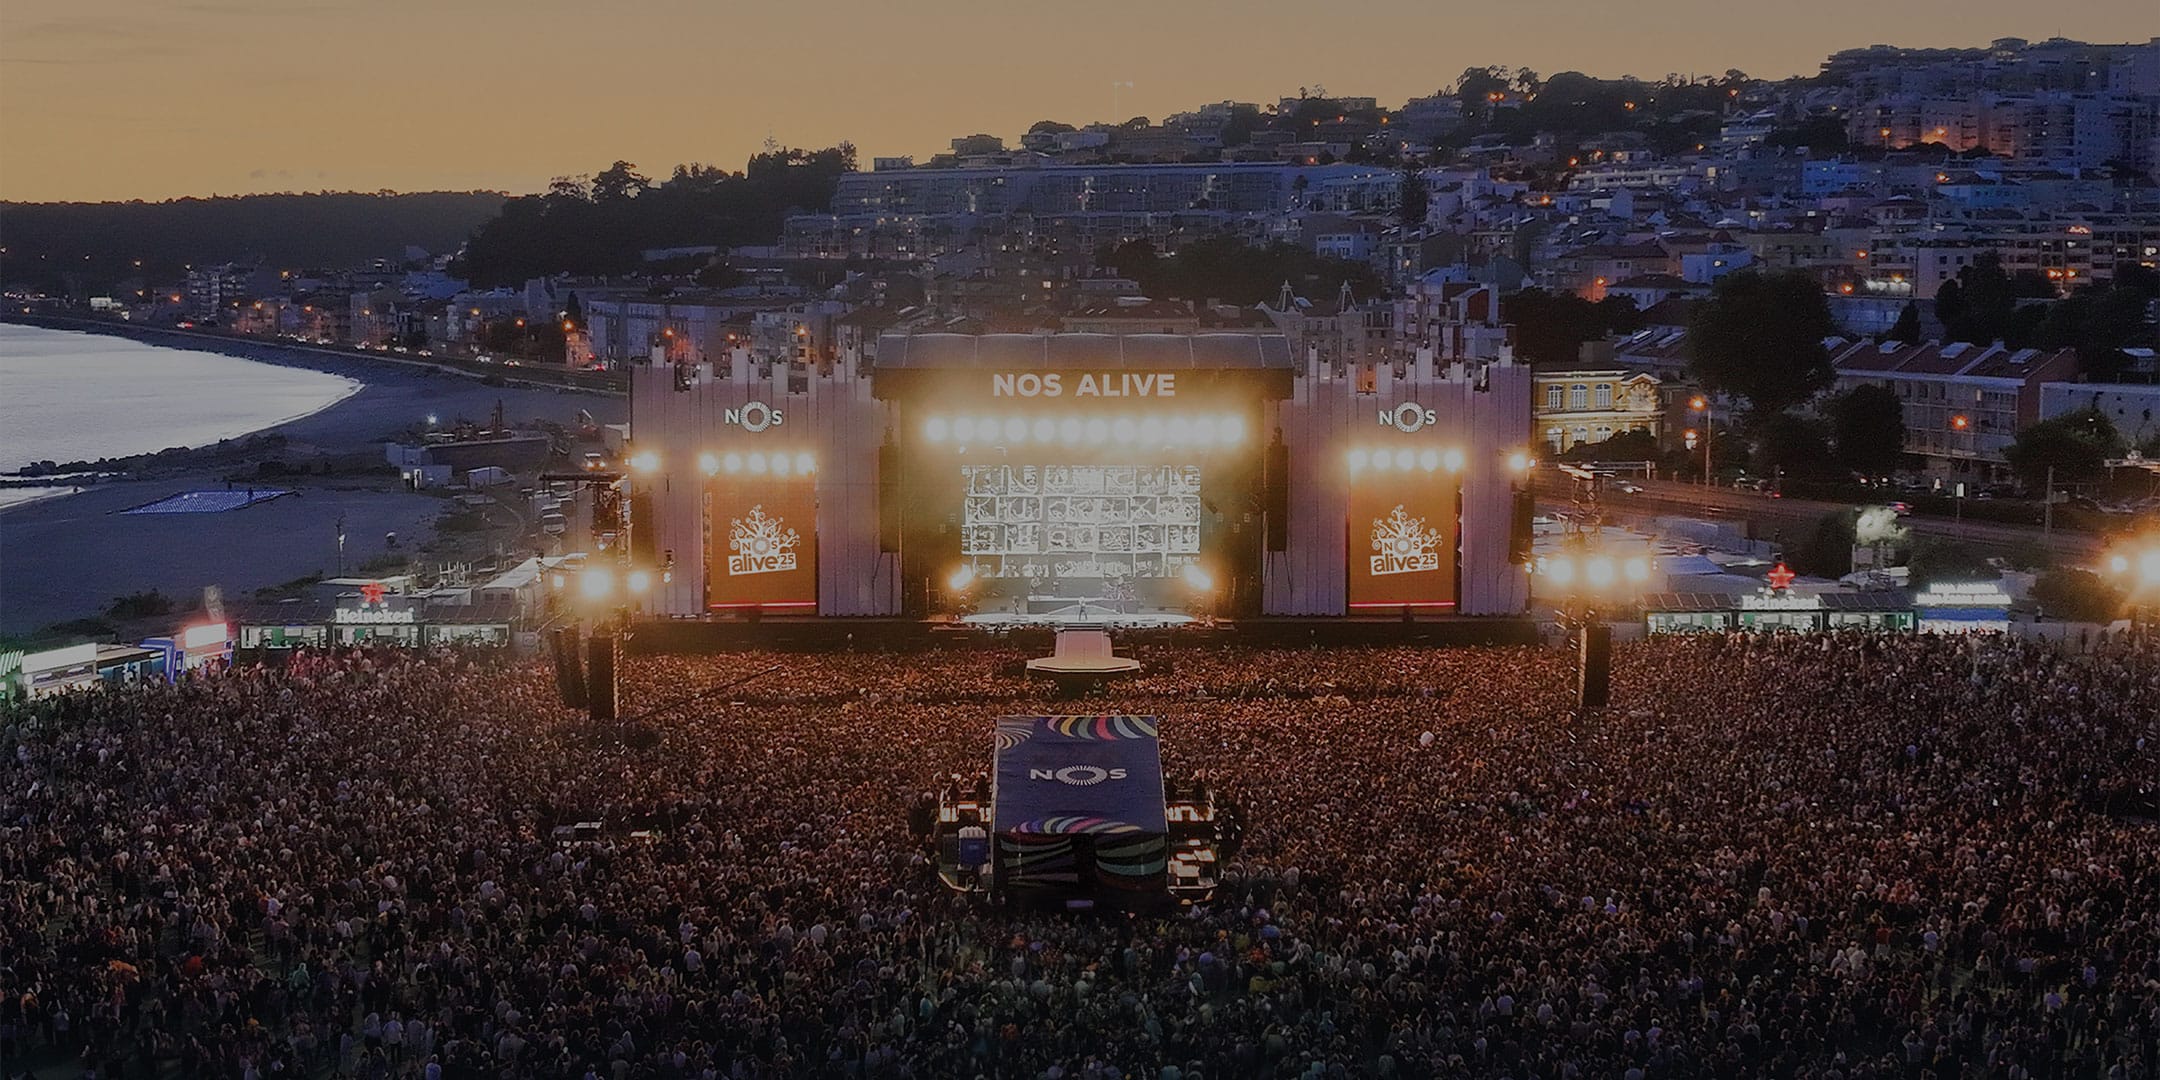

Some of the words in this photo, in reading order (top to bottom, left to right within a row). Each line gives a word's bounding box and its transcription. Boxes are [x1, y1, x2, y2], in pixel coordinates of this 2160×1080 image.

[993, 373, 1063, 397] NOS
[1075, 373, 1176, 397] ALIVE
[724, 401, 783, 433] NOS
[1379, 401, 1437, 433] NOS
[741, 536, 779, 555] NOS
[1384, 536, 1421, 555] NOS
[335, 607, 415, 624] Heineken
[1030, 765, 1128, 786] NOS
